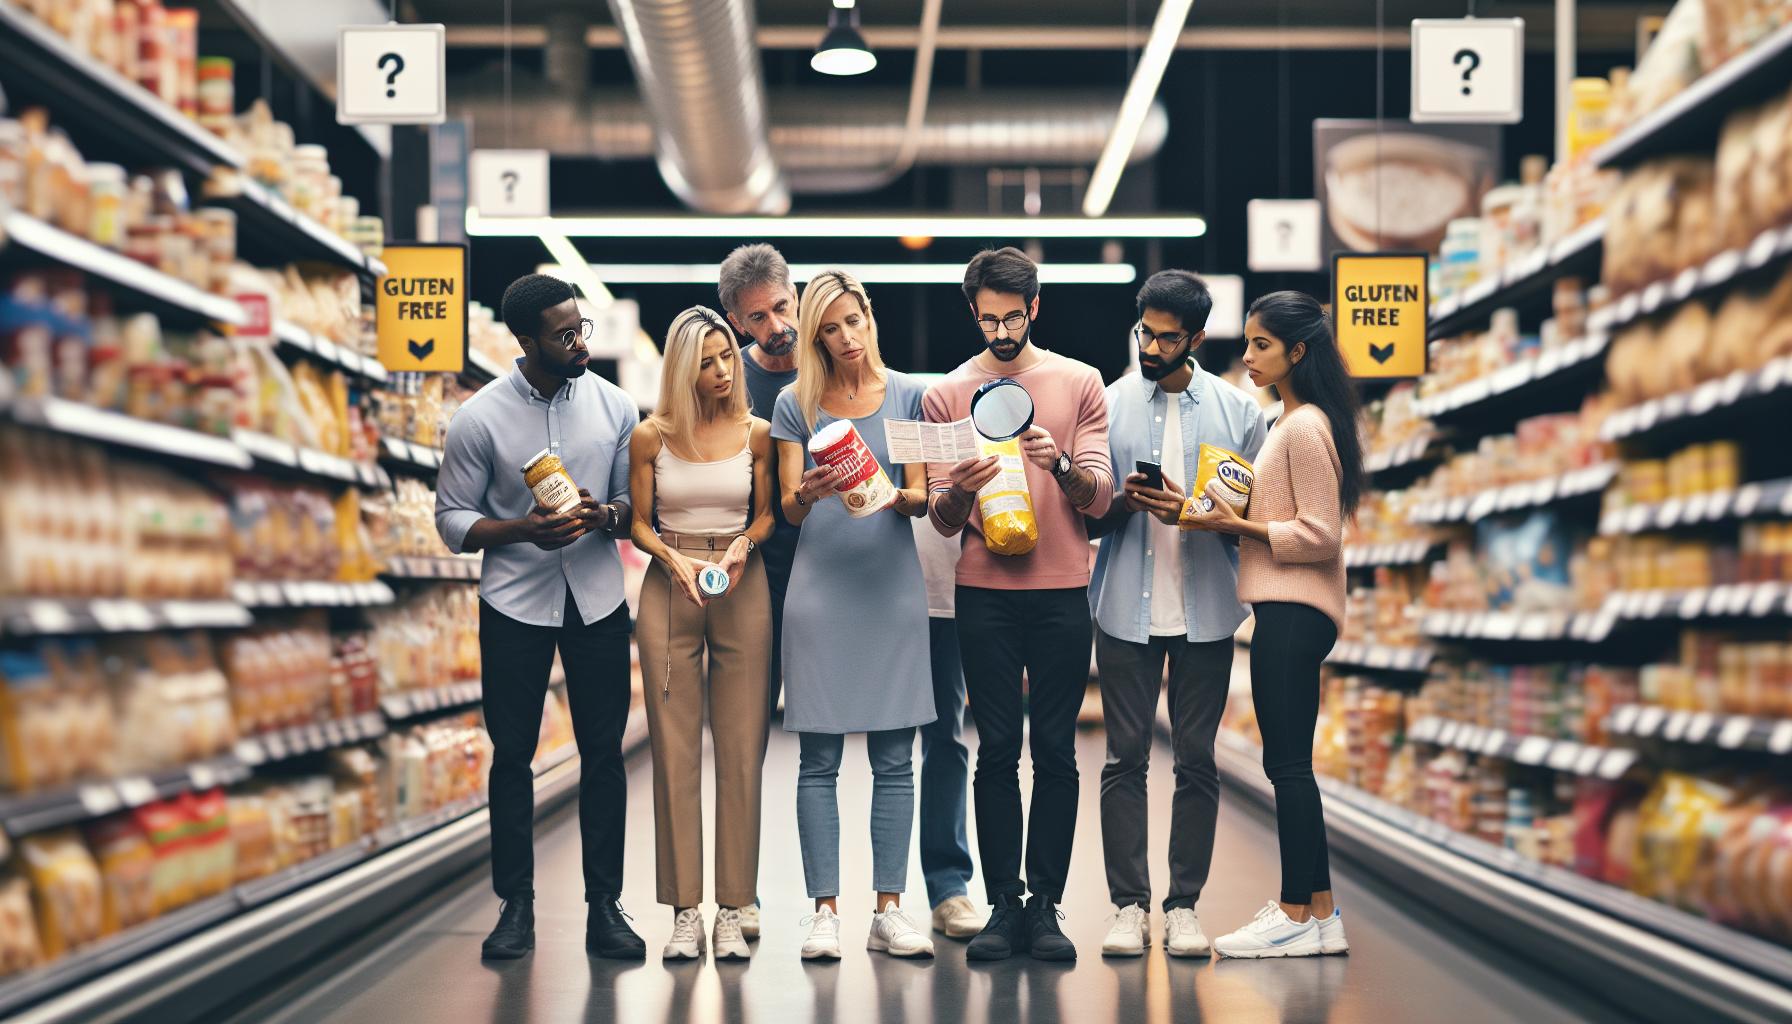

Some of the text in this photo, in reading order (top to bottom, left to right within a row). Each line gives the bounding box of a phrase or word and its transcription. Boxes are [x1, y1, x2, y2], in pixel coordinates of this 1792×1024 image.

[377, 52, 405, 98] ?
[1453, 49, 1480, 95] ?
[383, 278, 454, 296] GUTEN
[1345, 284, 1418, 302] GLUTEN
[1352, 308, 1400, 326] FREE
